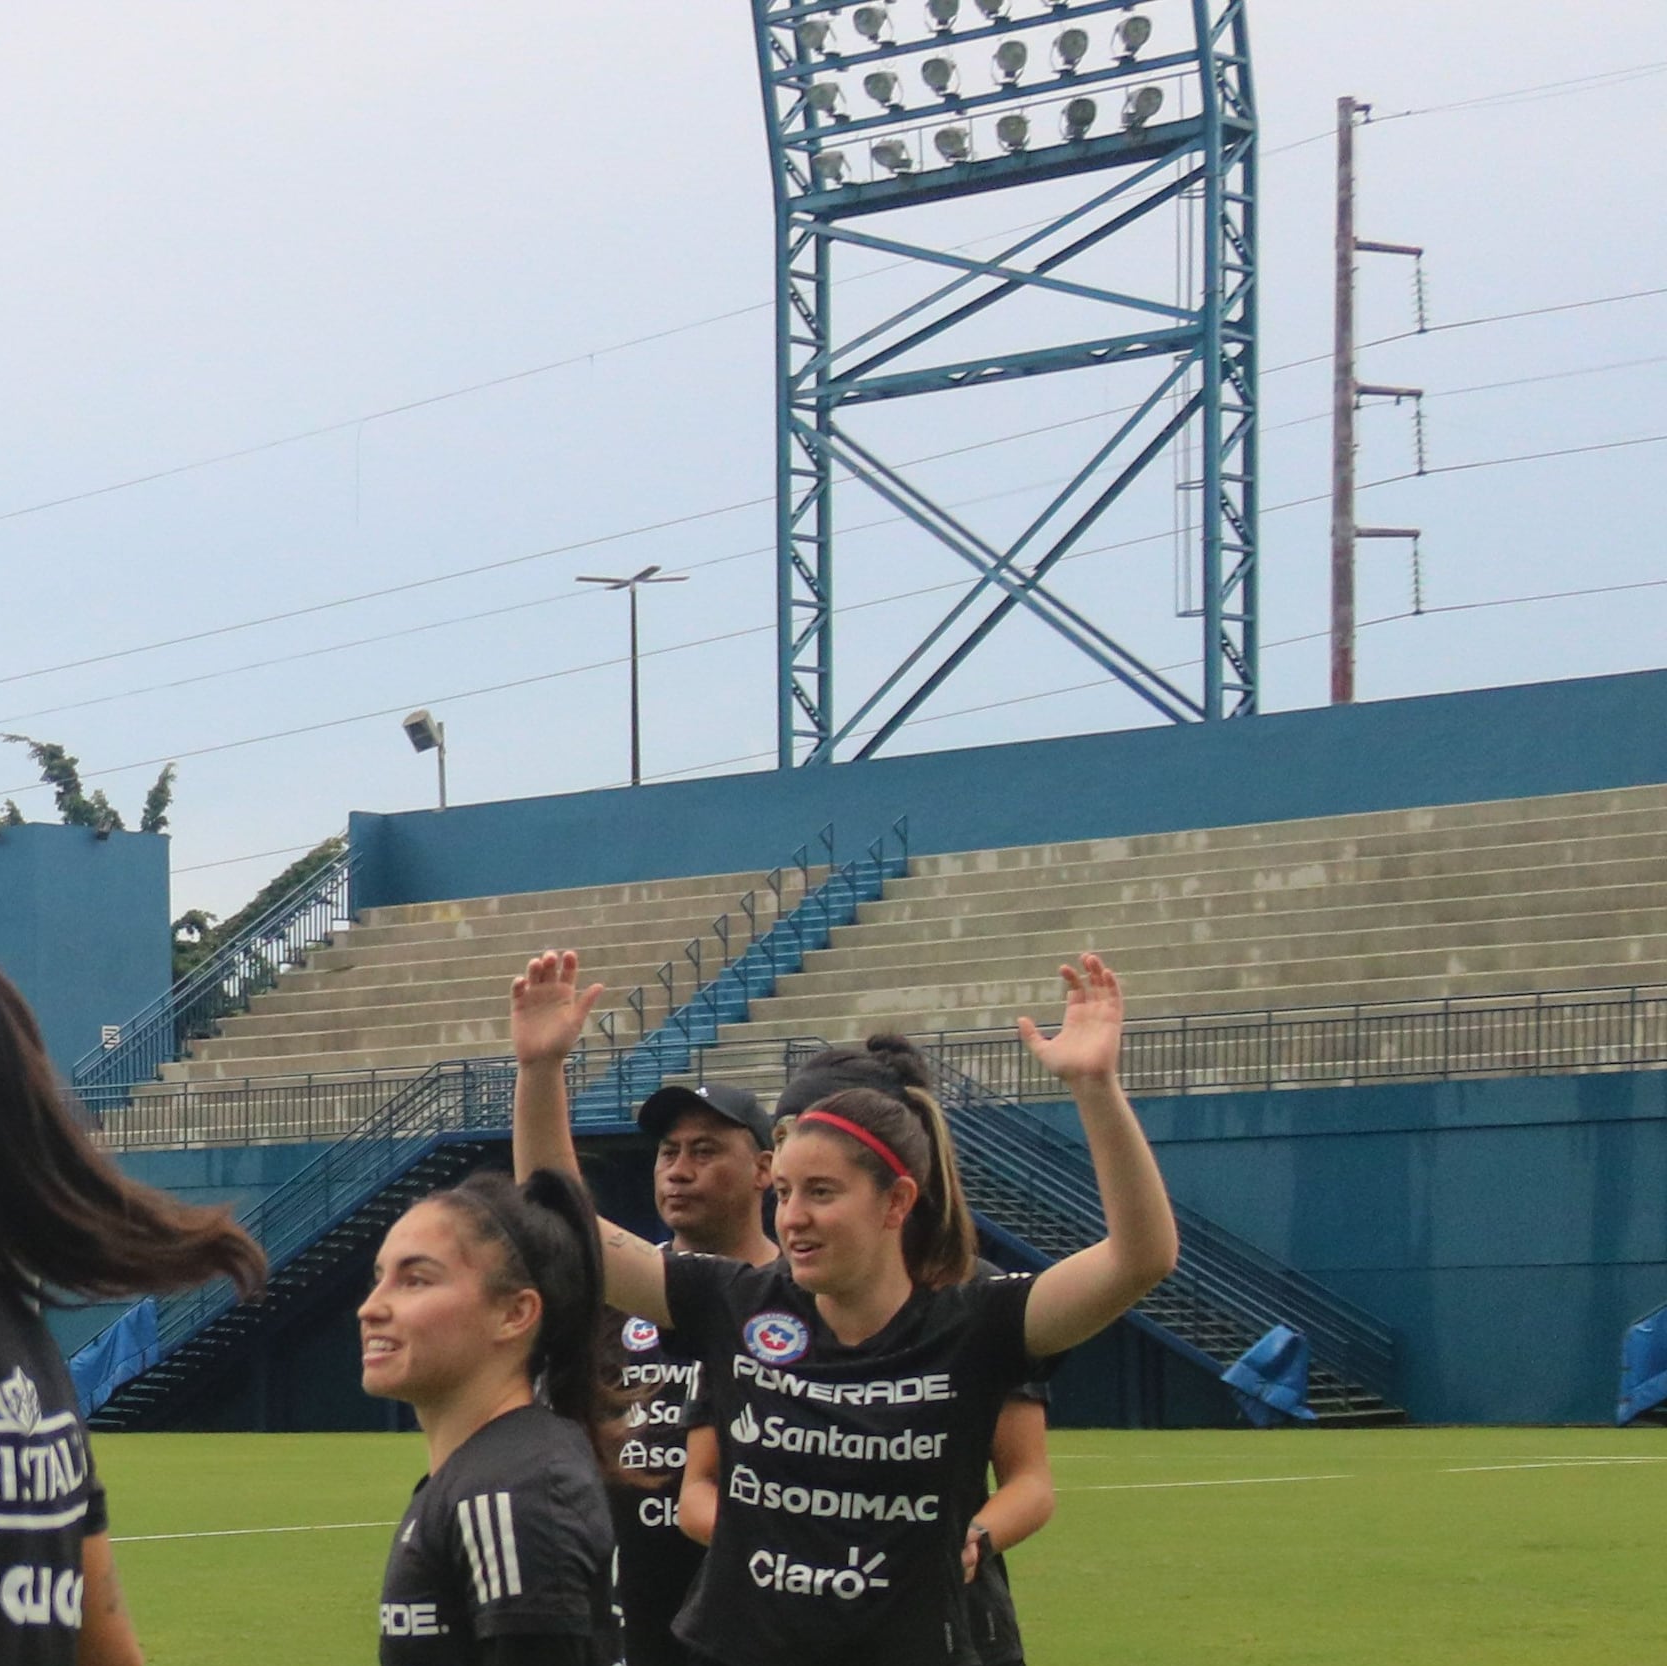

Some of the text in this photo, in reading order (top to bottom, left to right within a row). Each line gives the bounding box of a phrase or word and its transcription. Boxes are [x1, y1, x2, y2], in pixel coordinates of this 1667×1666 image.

[761, 1416, 948, 1461] Santander
[763, 1482, 939, 1521] SODIMAC
[749, 1549, 865, 1600] Claro
